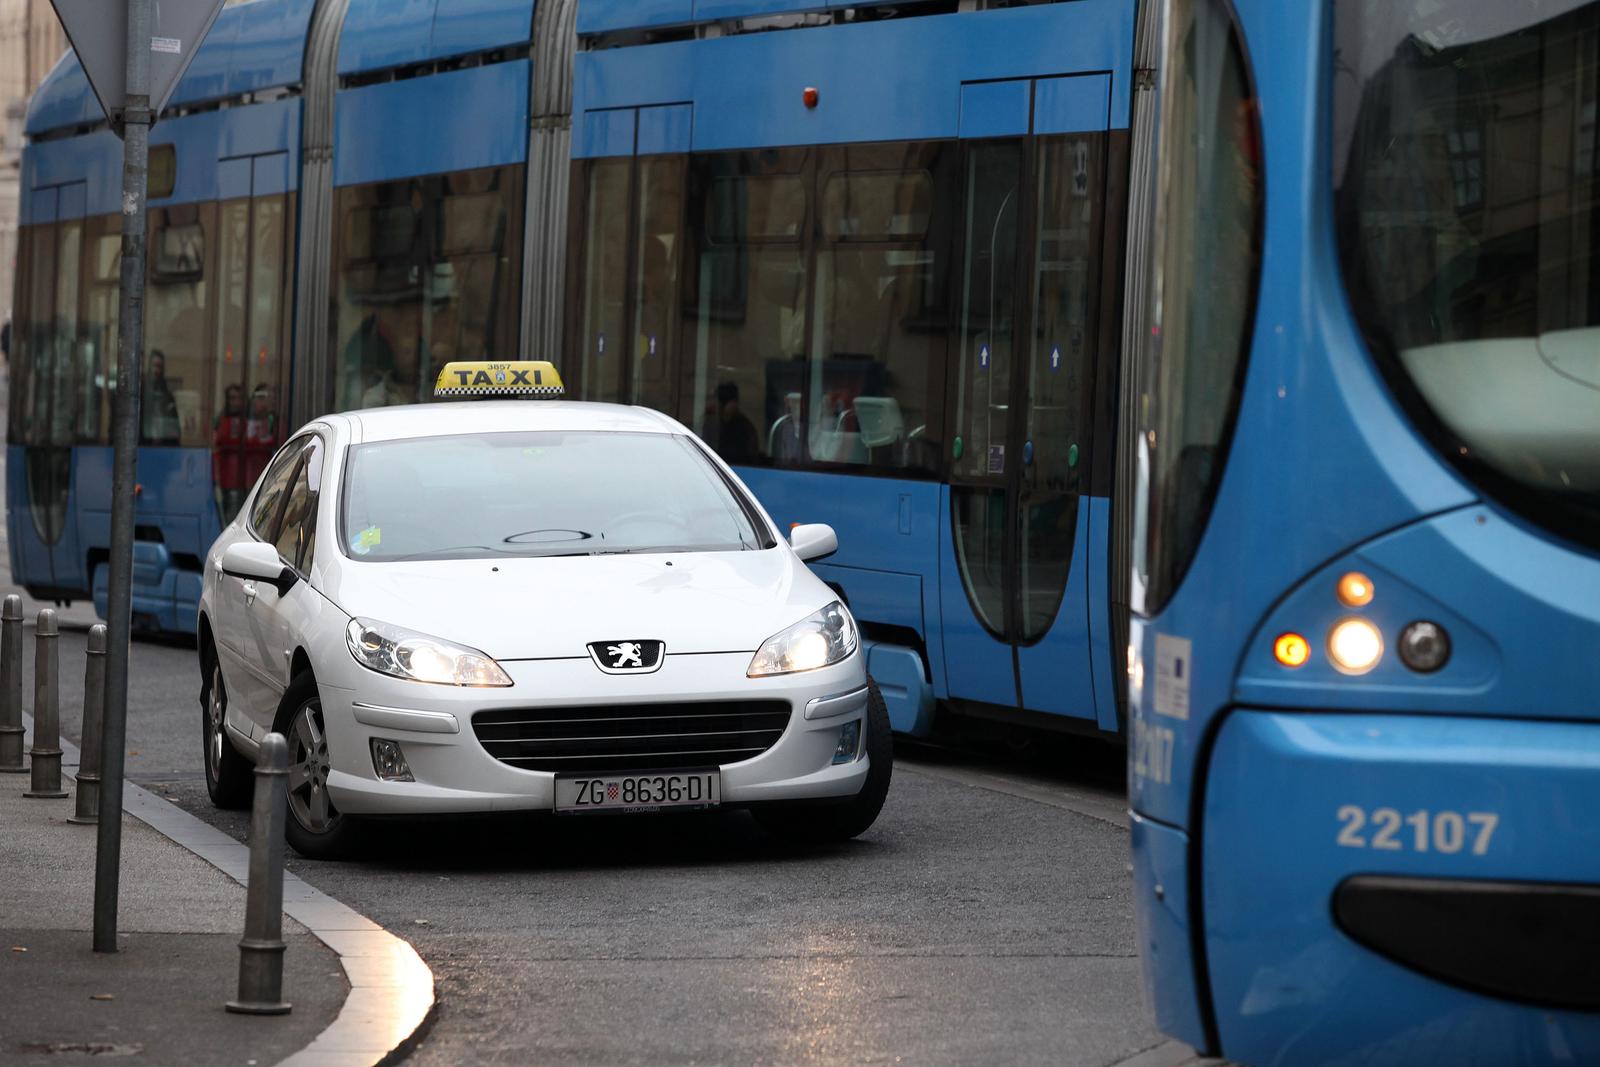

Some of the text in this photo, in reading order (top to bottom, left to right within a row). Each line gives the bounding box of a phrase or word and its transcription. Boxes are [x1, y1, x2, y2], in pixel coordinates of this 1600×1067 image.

[453, 370, 543, 386] TAXI
[574, 779, 605, 806] ZG
[1336, 804, 1500, 856] 22107
